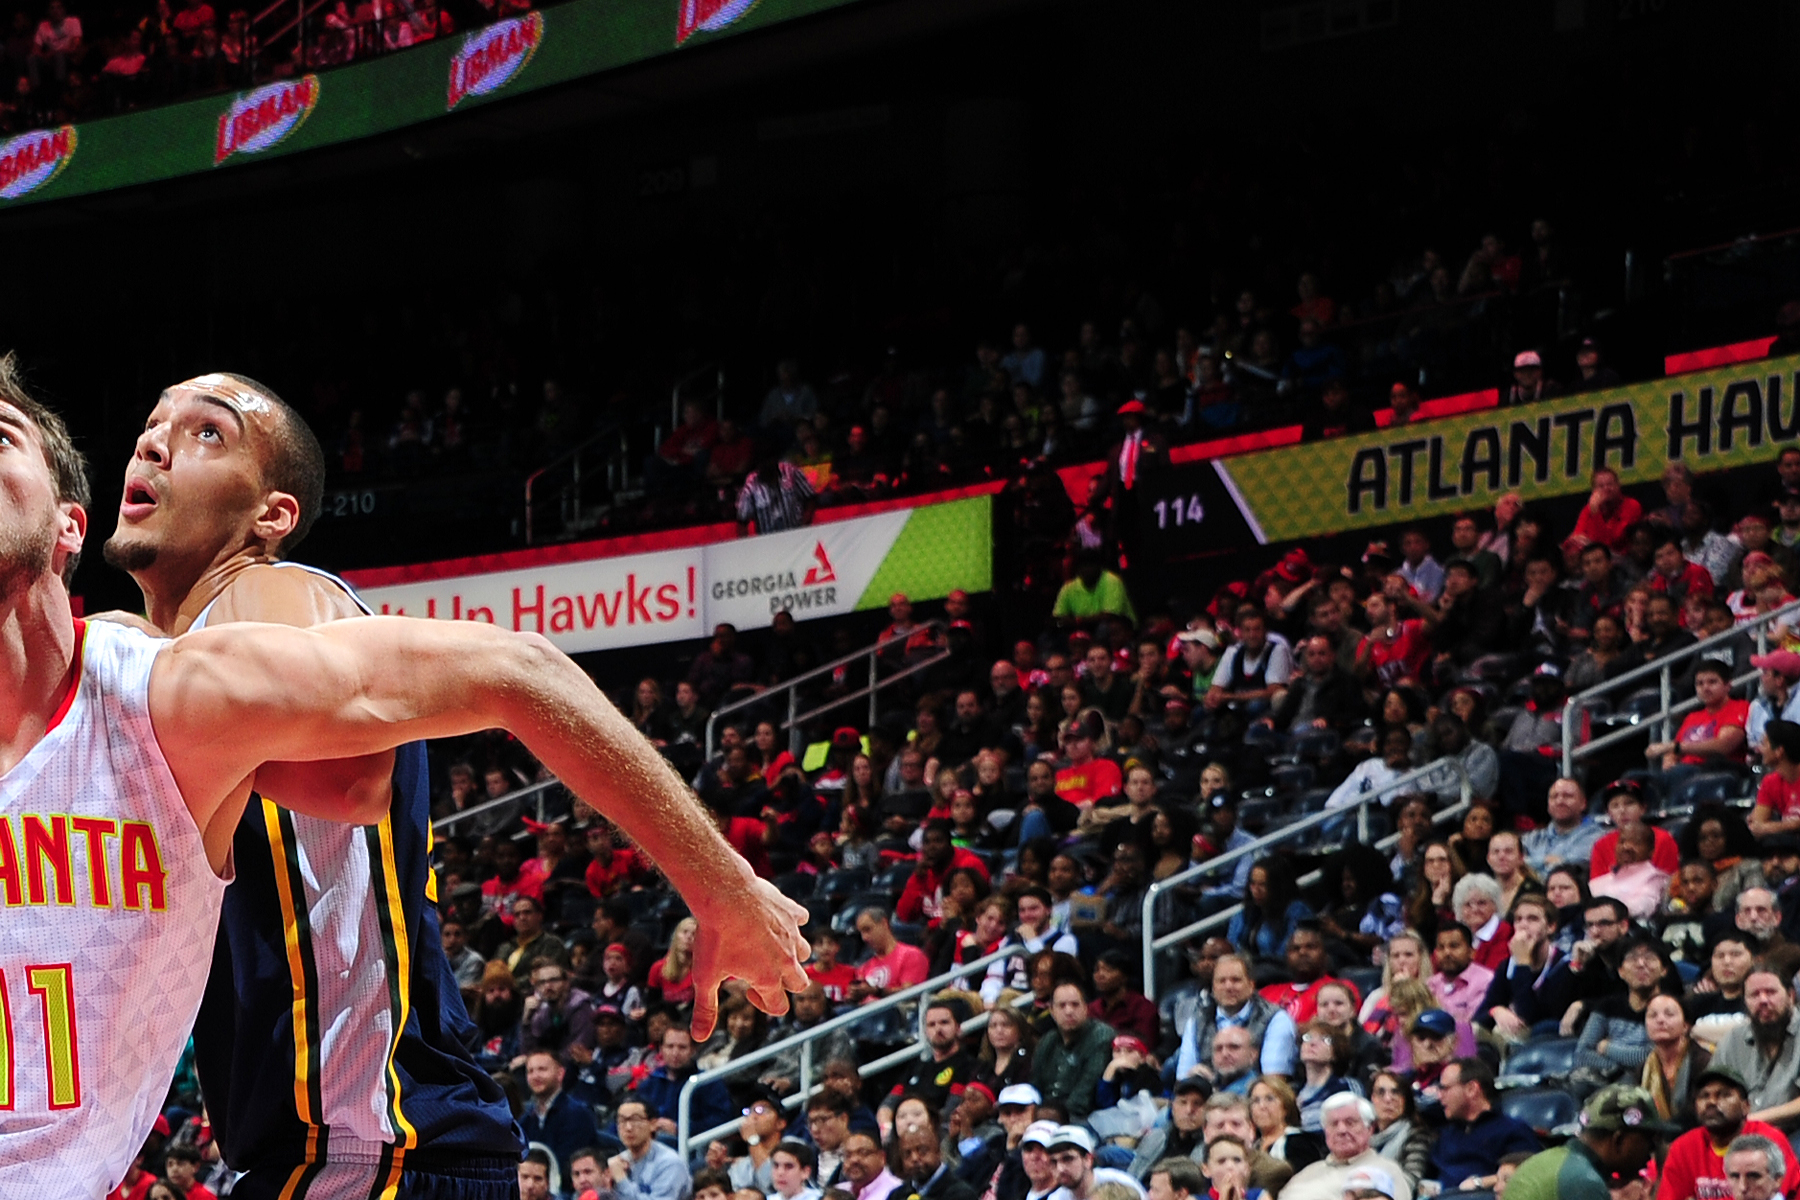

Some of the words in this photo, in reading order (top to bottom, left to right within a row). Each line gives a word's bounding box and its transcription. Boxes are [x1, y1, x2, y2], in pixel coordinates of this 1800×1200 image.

[445, 11, 541, 109] LIBMAN
[215, 74, 320, 164] LIBMAN
[1347, 402, 1638, 515] ATLANTA
[1153, 496, 1204, 529] 114
[511, 565, 697, 636] Hawks!
[711, 571, 797, 601] GEORGIA
[769, 586, 837, 615] POWER
